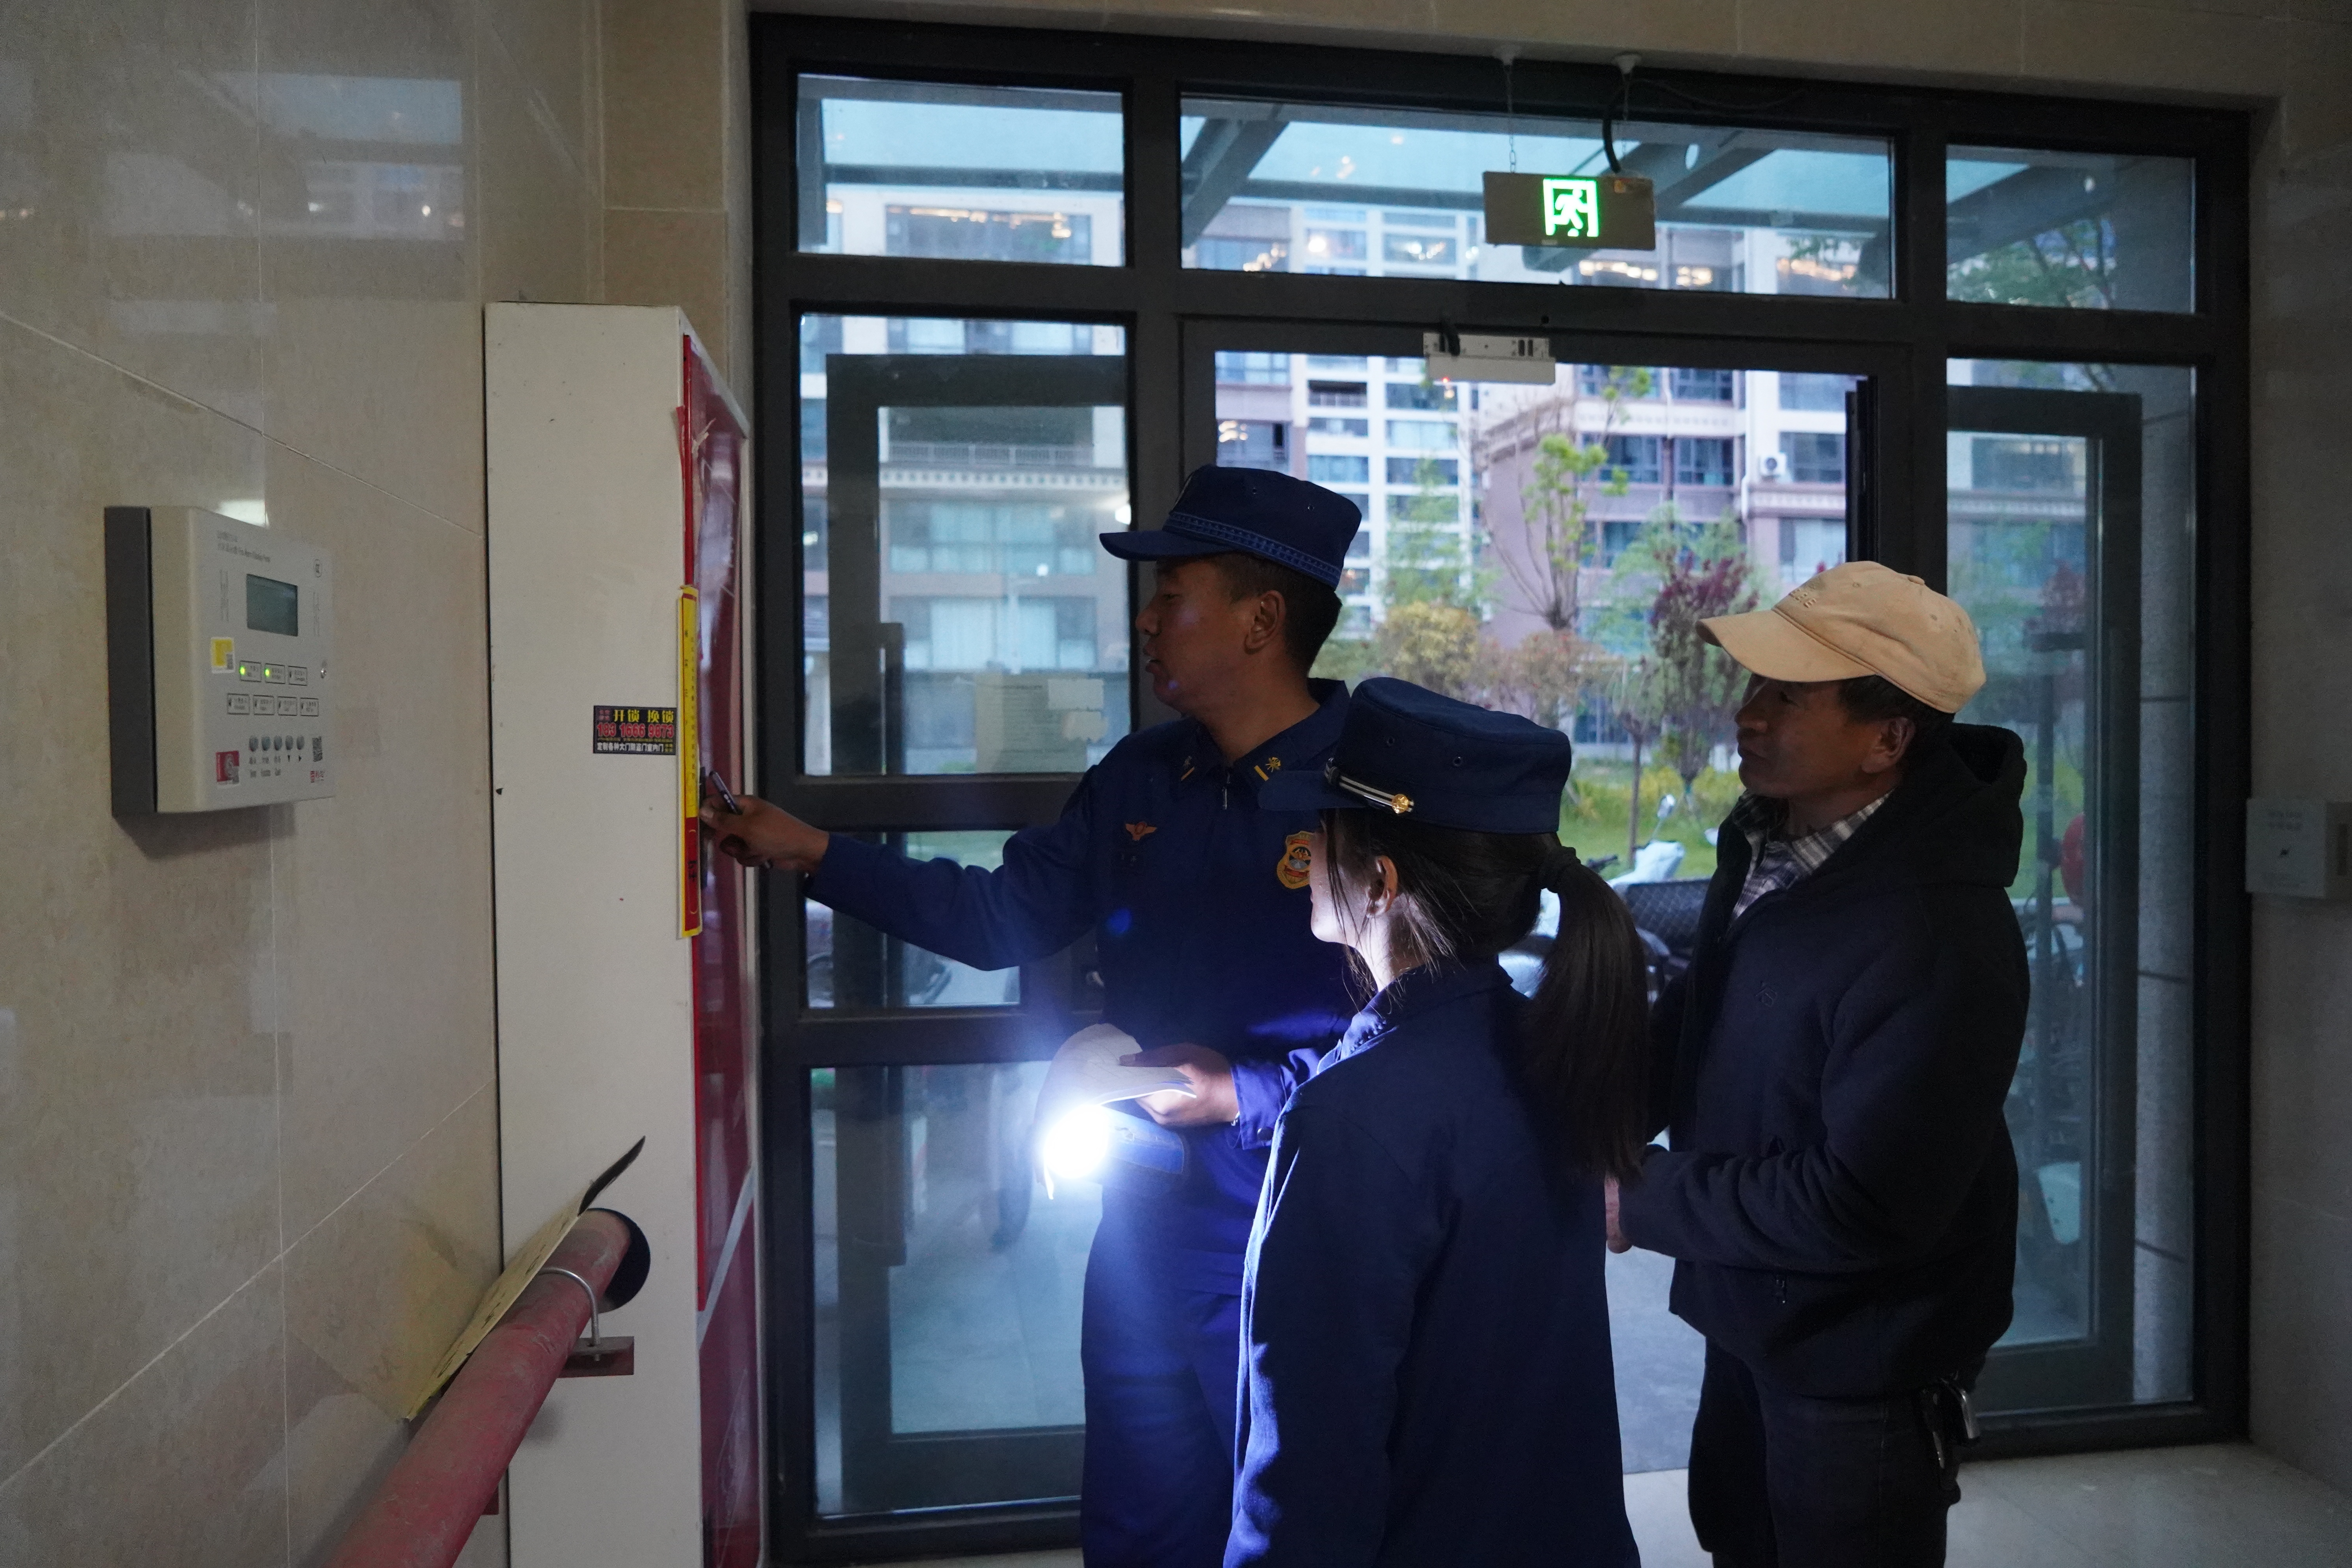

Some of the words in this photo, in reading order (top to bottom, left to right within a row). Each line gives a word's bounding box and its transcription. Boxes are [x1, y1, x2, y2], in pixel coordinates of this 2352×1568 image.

[614, 709, 639, 722] 开锁
[648, 710, 674, 723] 换锁
[597, 722, 617, 737] 183
[619, 723, 646, 738] 1666
[648, 723, 674, 739] 9873
